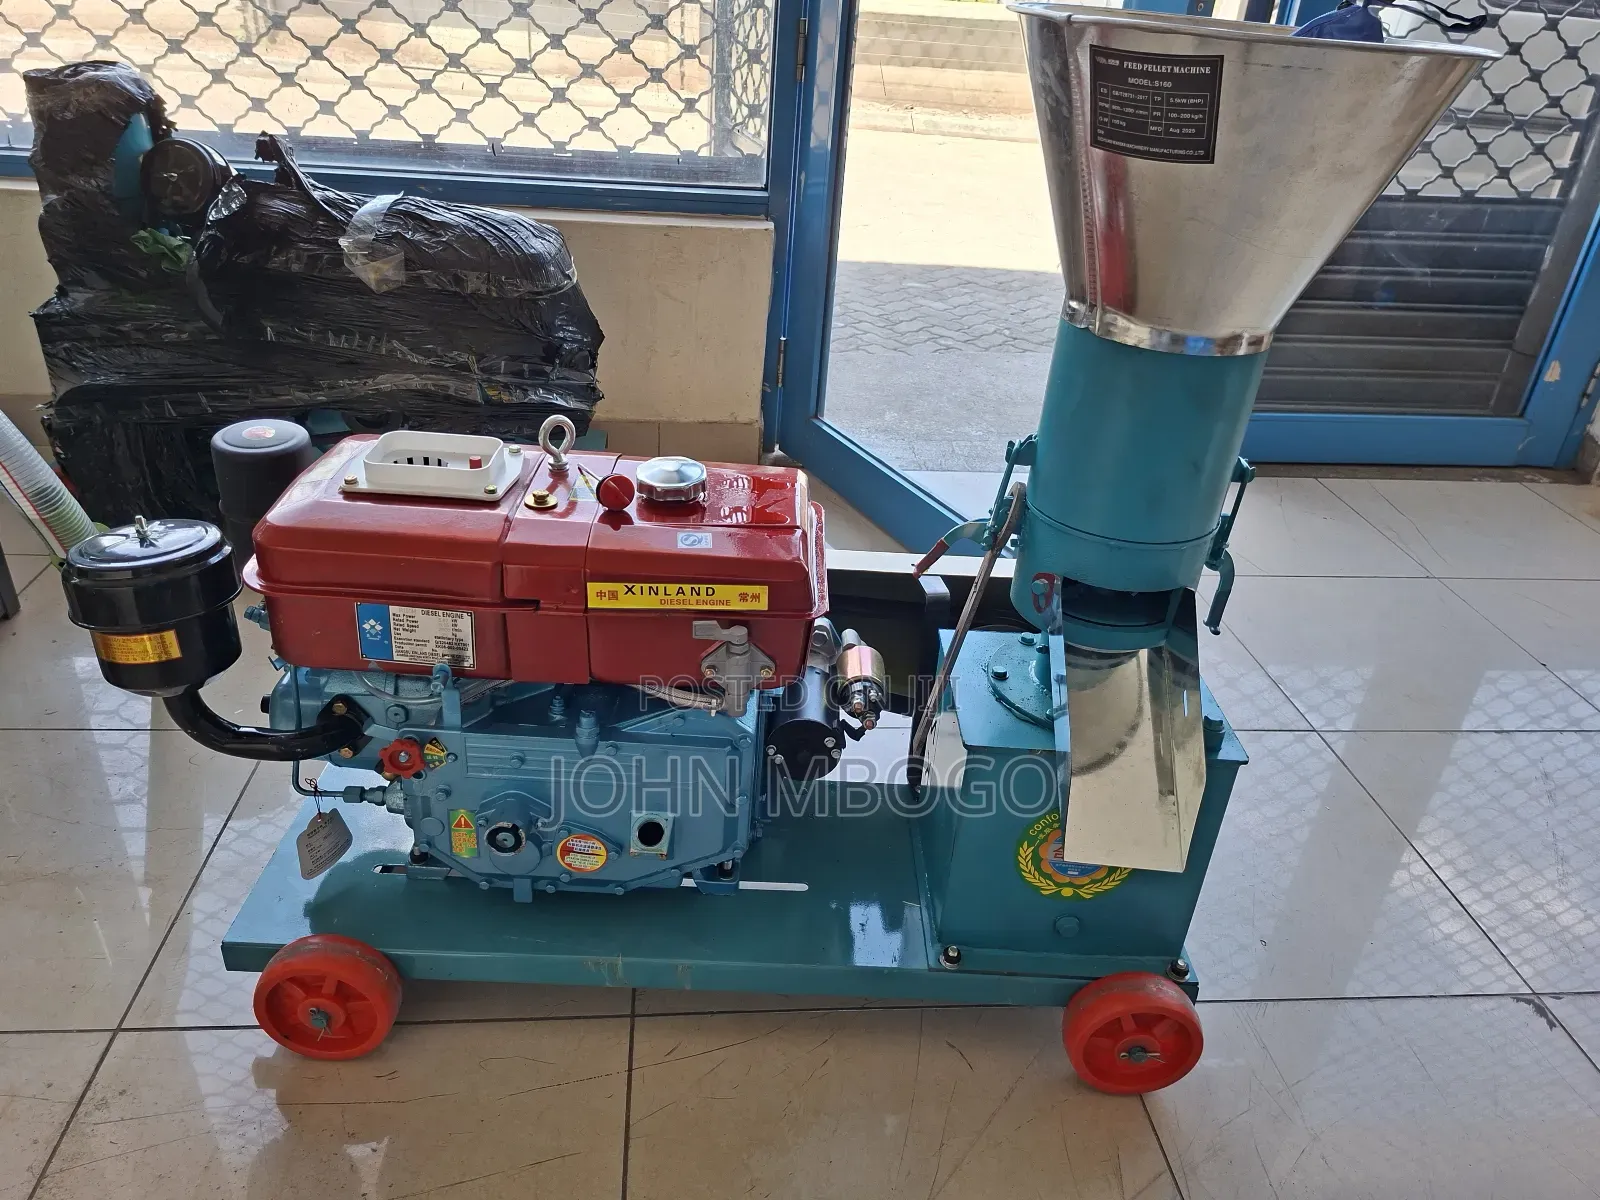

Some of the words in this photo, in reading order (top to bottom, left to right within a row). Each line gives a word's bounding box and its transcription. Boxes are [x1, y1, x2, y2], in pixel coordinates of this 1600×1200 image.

[1123, 61, 1143, 71] FEED
[1143, 64, 1173, 73] PELLET
[1173, 66, 1211, 74] MACHINE
[1128, 77, 1172, 88] MODEL:S160
[596, 589, 619, 601] 中国
[623, 584, 716, 597] XINLAND
[659, 598, 694, 606] DIESEL
[695, 598, 731, 607] ENGINE
[738, 591, 761, 604] 常州
[421, 609, 441, 618] DIESEL
[442, 611, 465, 620] ENGINE
[1029, 812, 1060, 836] confo
